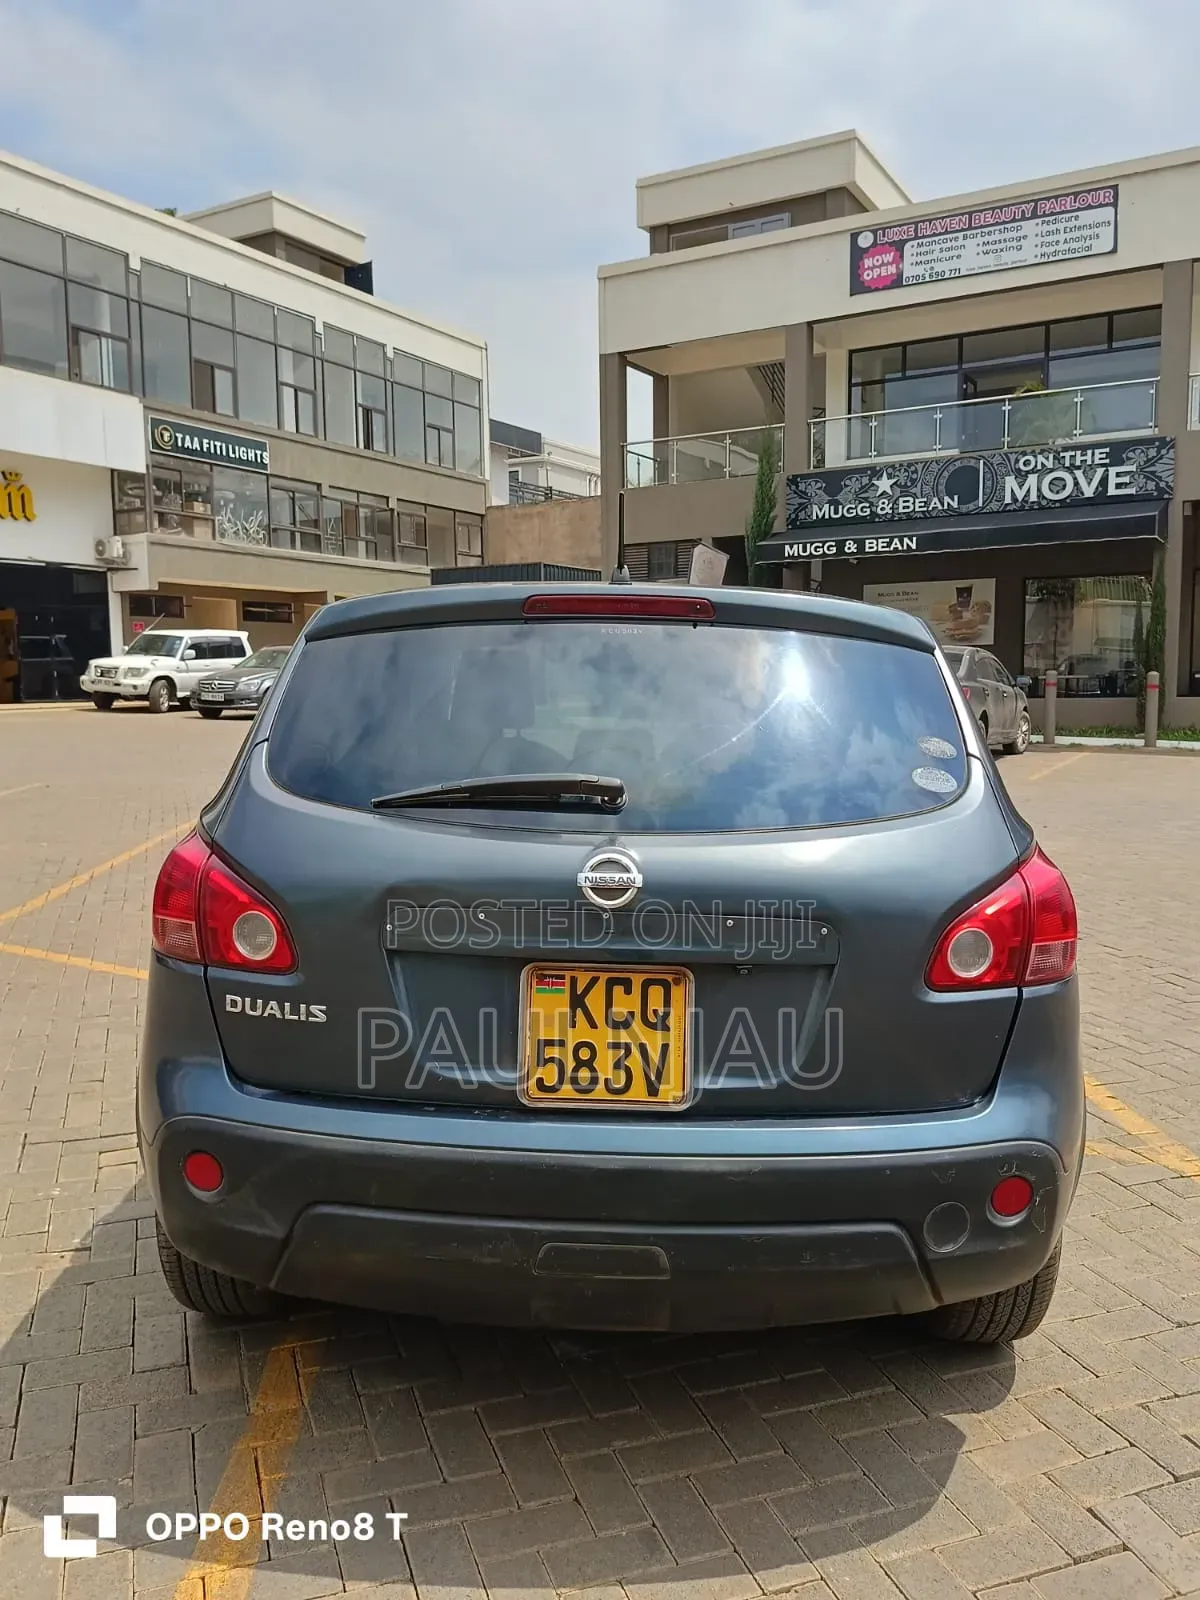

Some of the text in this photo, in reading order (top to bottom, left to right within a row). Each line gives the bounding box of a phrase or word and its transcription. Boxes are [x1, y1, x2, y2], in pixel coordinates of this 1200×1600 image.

[877, 189, 1113, 244] LUXE HAVEN BEAUTY PARLOUR
[1041, 214, 1079, 227] Pedicure
[916, 224, 1023, 249] Mancave Barbershop
[1041, 220, 1111, 238] Lash Extensions
[982, 234, 1028, 247] Massage
[1040, 231, 1100, 249] Face Analysis
[915, 243, 966, 258] Hair Salon
[982, 244, 1023, 256] Waxing
[1040, 244, 1093, 260] Hydrafacial
[864, 252, 894, 269] NOW
[915, 253, 962, 267] Manicure
[863, 264, 896, 280] OPEN
[904, 268, 961, 284] 0705 690 771
[175, 433, 270, 464] TAA FITI LIGHTS
[1019, 447, 1110, 471] ON THE
[1004, 463, 1137, 504] MOVE
[877, 499, 893, 515] &
[784, 536, 917, 558] MUGG & BEAN
[584, 876, 636, 885] NISSAN
[225, 994, 327, 1023] DUALIS
[568, 975, 672, 1032] KCQ
[536, 1038, 670, 1098] 583V
